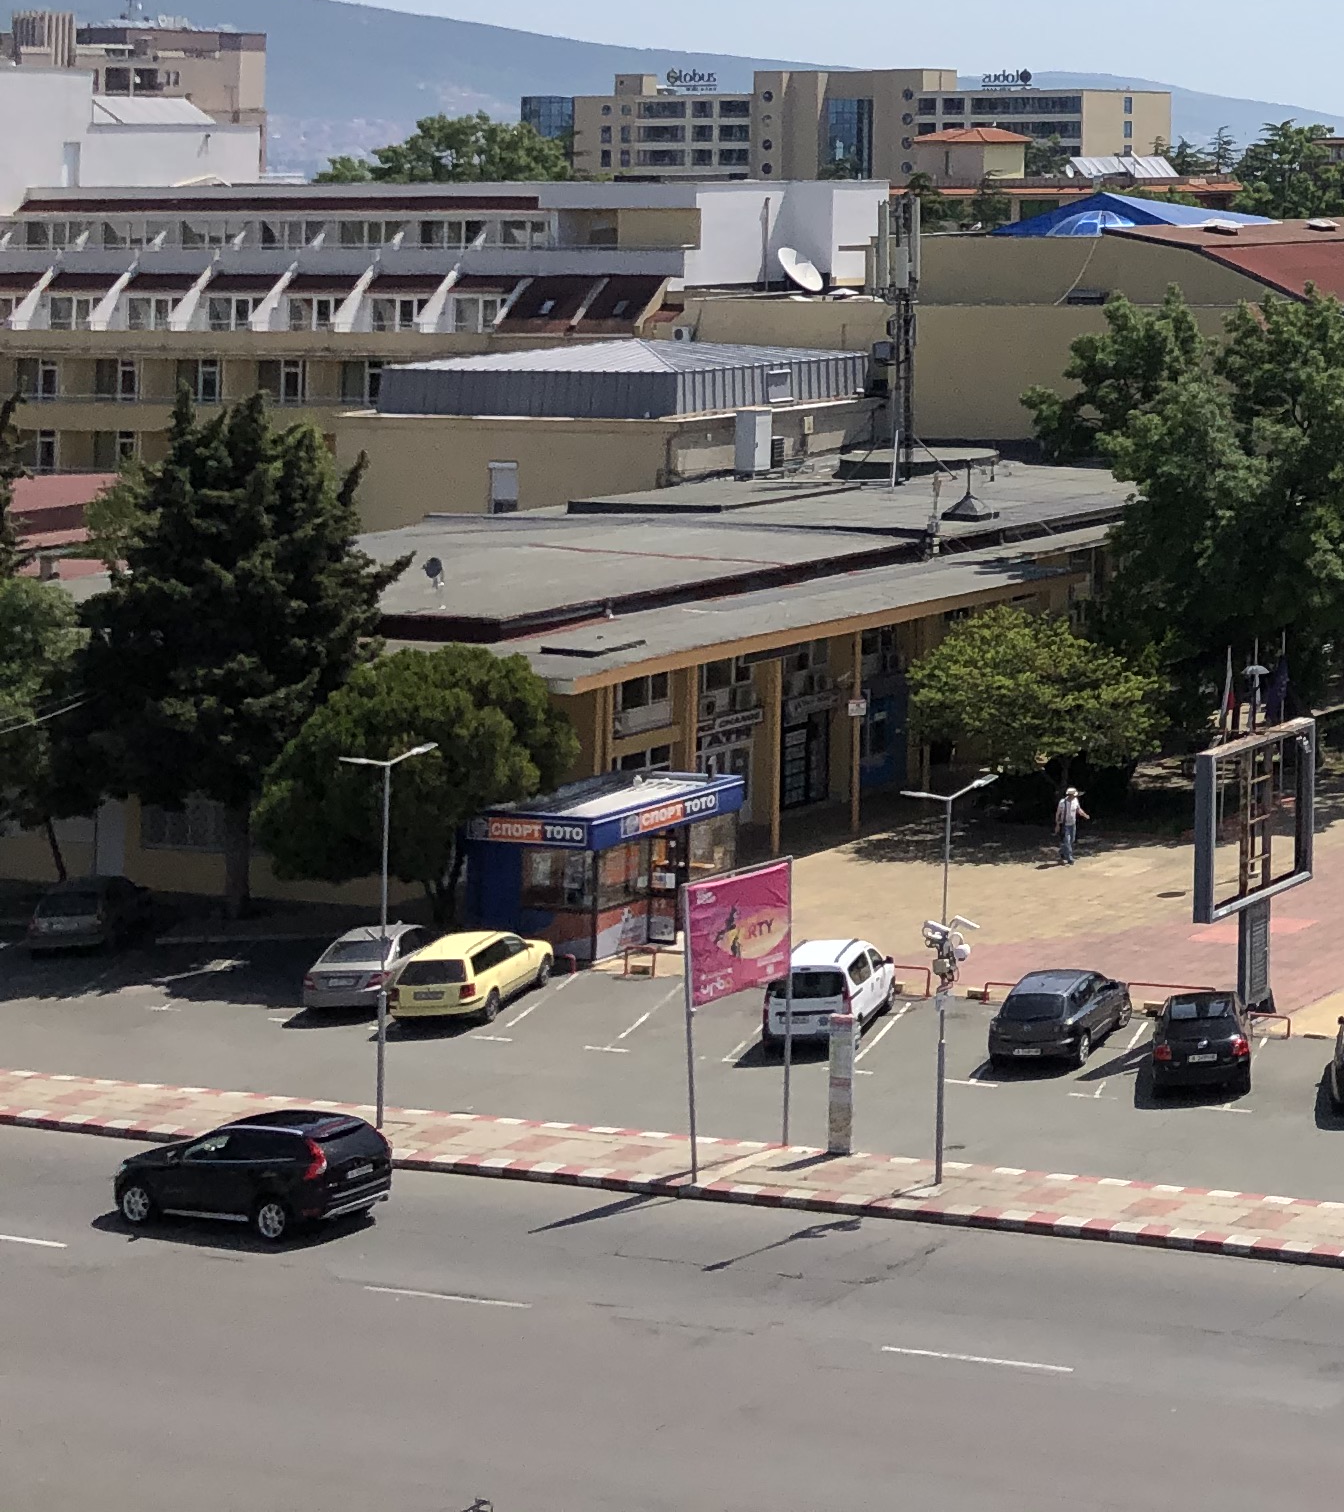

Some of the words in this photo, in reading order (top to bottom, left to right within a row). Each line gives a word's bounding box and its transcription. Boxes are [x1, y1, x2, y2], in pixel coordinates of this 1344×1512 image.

[641, 803, 683, 826] СПОРТ
[685, 794, 717, 814] ТОТО
[490, 820, 542, 839] СПОРТ
[544, 824, 584, 841] ТОТО
